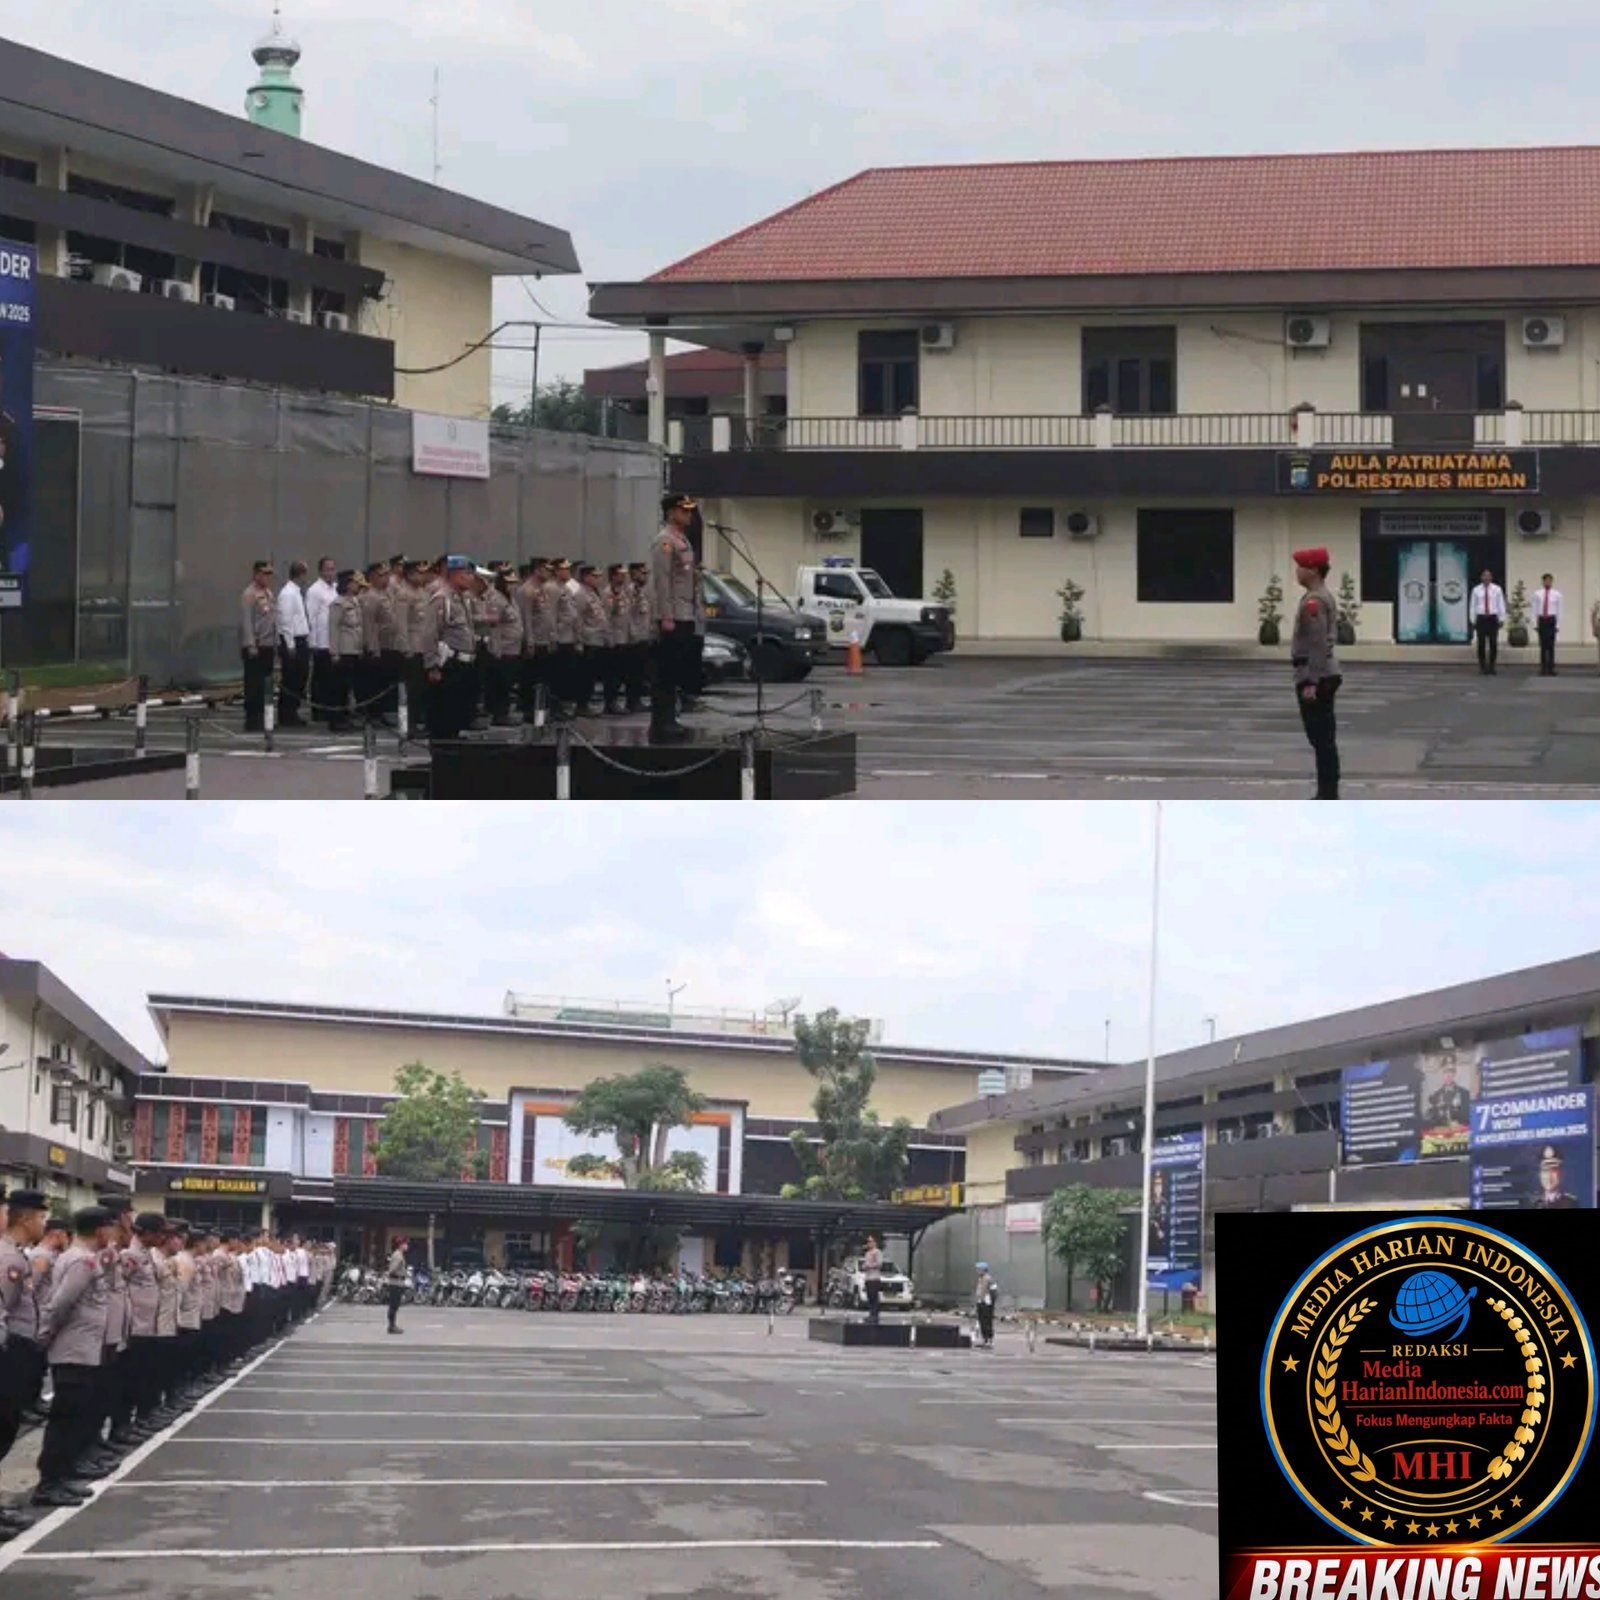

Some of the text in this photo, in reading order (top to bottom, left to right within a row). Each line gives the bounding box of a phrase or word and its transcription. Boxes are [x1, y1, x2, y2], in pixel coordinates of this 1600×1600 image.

[1330, 454, 1511, 470] AULA PATRIATAMA
[1316, 472, 1527, 489] POLRESTABES MEDAN
[1476, 1092, 1586, 1130] 7 COMMANDER
[1492, 1116, 1522, 1130] WISH
